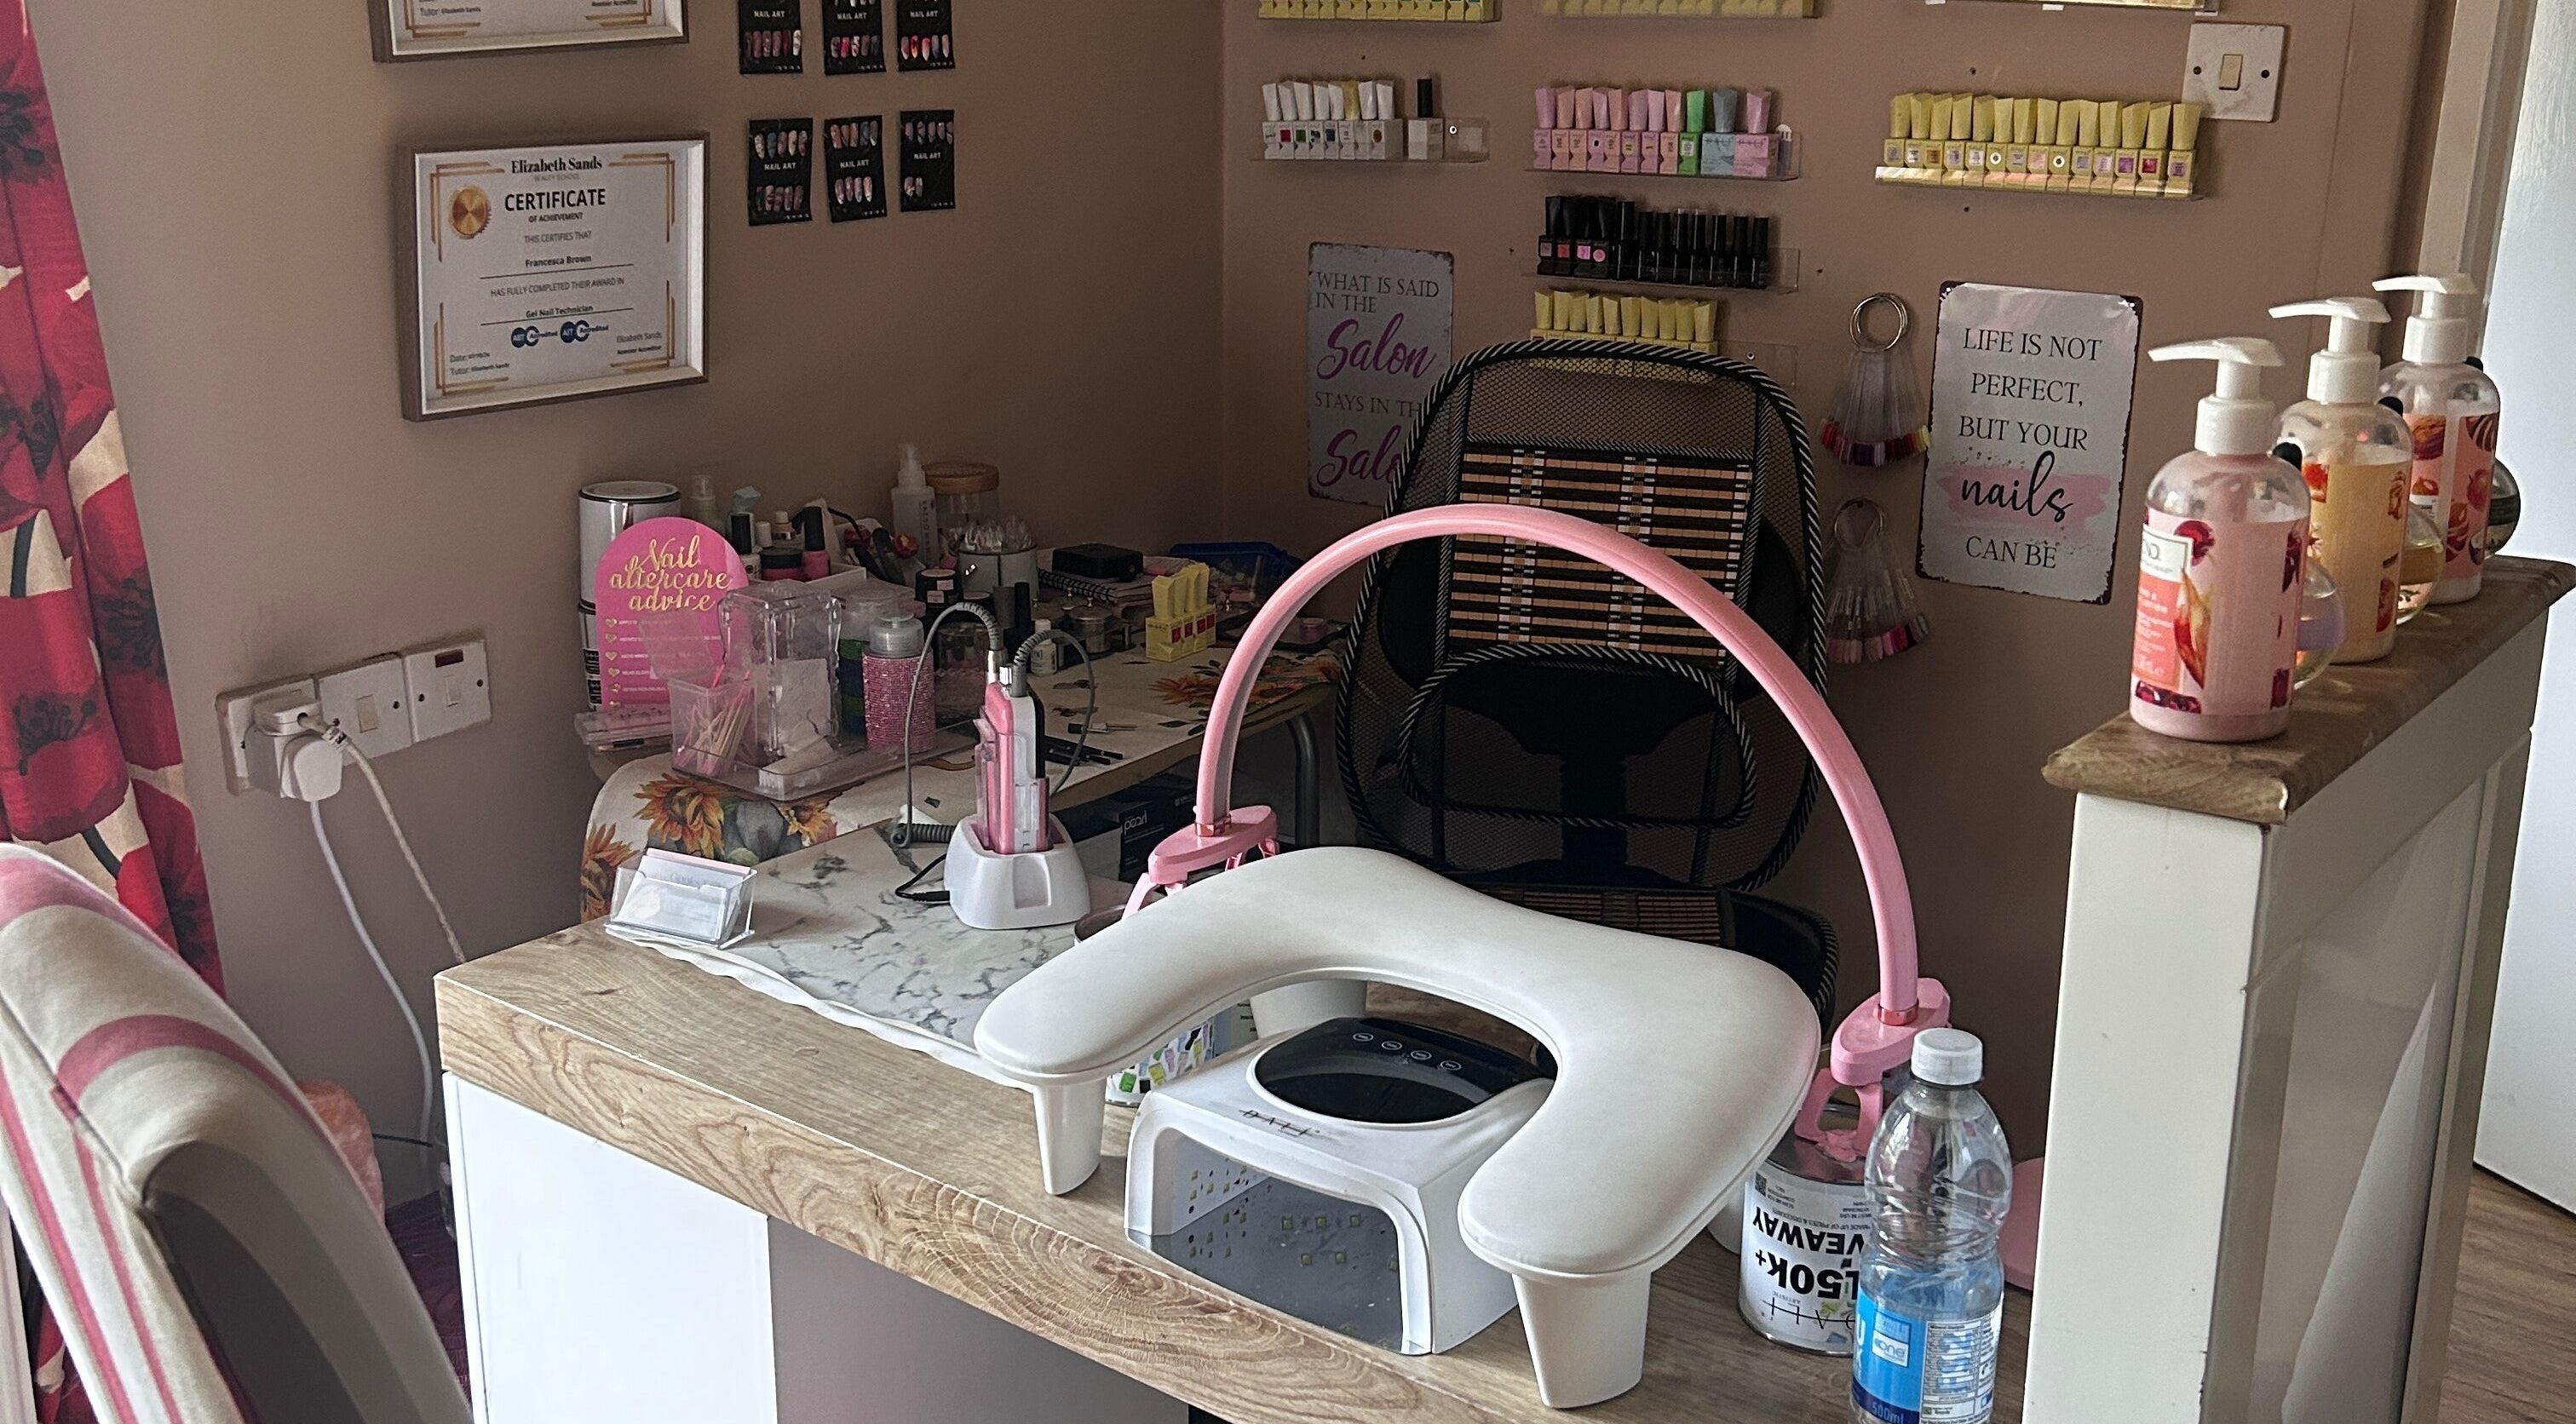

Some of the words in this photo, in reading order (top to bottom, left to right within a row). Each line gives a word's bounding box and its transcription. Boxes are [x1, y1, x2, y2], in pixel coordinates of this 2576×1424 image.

[511, 158, 566, 174] Elizabeth
[568, 156, 602, 170] Sands
[504, 188, 606, 211] CERTIFICATE
[538, 212, 584, 222] ACHIEVEMENT
[524, 234, 540, 244] THIS
[541, 233, 573, 243] CERTIFIES
[574, 230, 592, 240] THAT
[526, 257, 565, 267] Francesca
[566, 256, 592, 264] Brown
[491, 288, 505, 296] HAS
[507, 286, 527, 296] FULLY
[528, 281, 570, 293] COMPLETED
[572, 279, 589, 289] THEIR
[591, 278, 616, 287] AWARD
[618, 277, 624, 285] IN
[1316, 272, 1371, 293] WHAT
[1377, 277, 1391, 295] IS
[1397, 278, 1439, 298] SAID
[526, 310, 538, 319] Gel
[539, 307, 554, 317] Nail
[555, 305, 594, 316] Technician
[1315, 292, 1335, 309] IN
[1342, 295, 1377, 313] THE
[1316, 313, 1437, 380] Salon
[1963, 328, 2013, 354] LIFE
[2021, 333, 2042, 356] IS
[2049, 336, 2102, 362] NOT
[1971, 373, 2083, 407] PERFECT,
[1314, 392, 1363, 411] STAYS
[1370, 397, 1390, 415] IN
[1397, 401, 1422, 418] TH
[1959, 415, 2010, 441] BUT
[2016, 421, 2089, 451] YOUR
[1316, 425, 1404, 487] Salo
[1961, 450, 2073, 523] nails
[639, 535, 701, 571] Nail
[1966, 536, 2019, 563] CAN
[2024, 543, 2058, 569] BE
[609, 555, 733, 590] aftercare
[629, 586, 716, 612] advice
[1752, 1206, 1865, 1255] VEAWAY
[1872, 1402, 1905, 1424] 500ml
